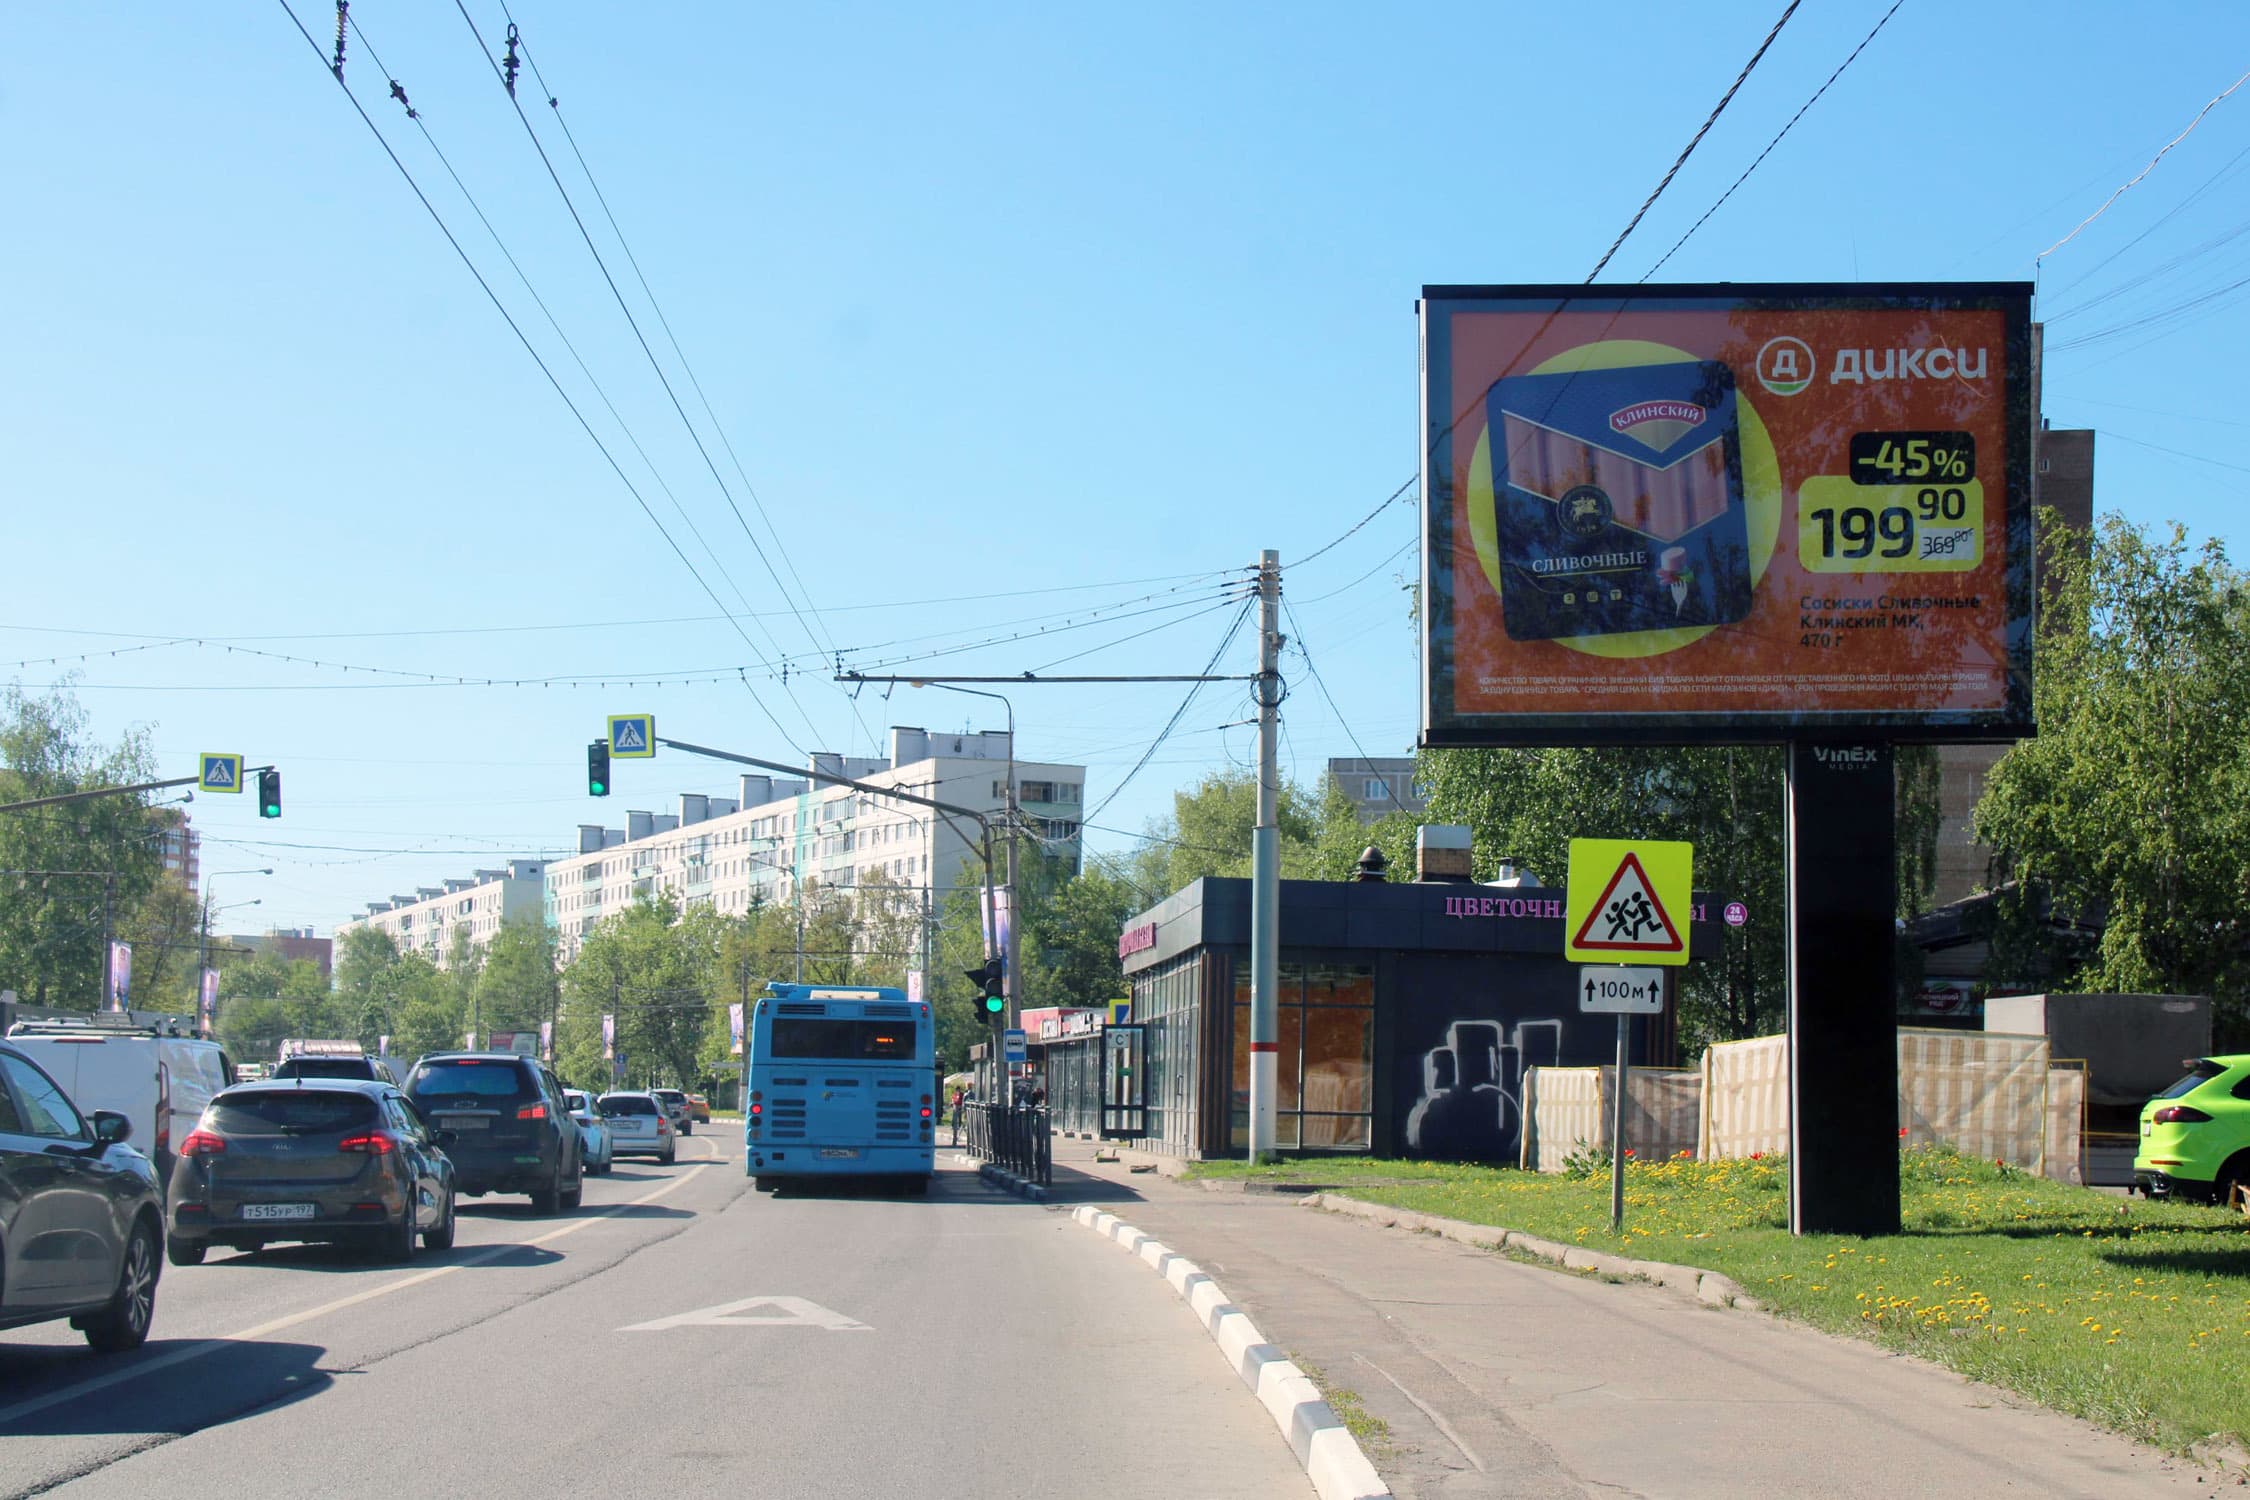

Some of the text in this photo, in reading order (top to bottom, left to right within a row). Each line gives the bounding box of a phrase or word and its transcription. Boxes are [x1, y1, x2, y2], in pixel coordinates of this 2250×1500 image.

[1616, 406, 1699, 427] КЛИНСКИЙ
[1532, 551, 1648, 573] СЛИВОЧНЫЕ
[1800, 596, 1980, 610] Сосиски Сливочные
[1800, 614, 1887, 629] Клинский
[1800, 634, 1831, 647] 470
[1445, 896, 1567, 919] ЦВЕТОЧН
